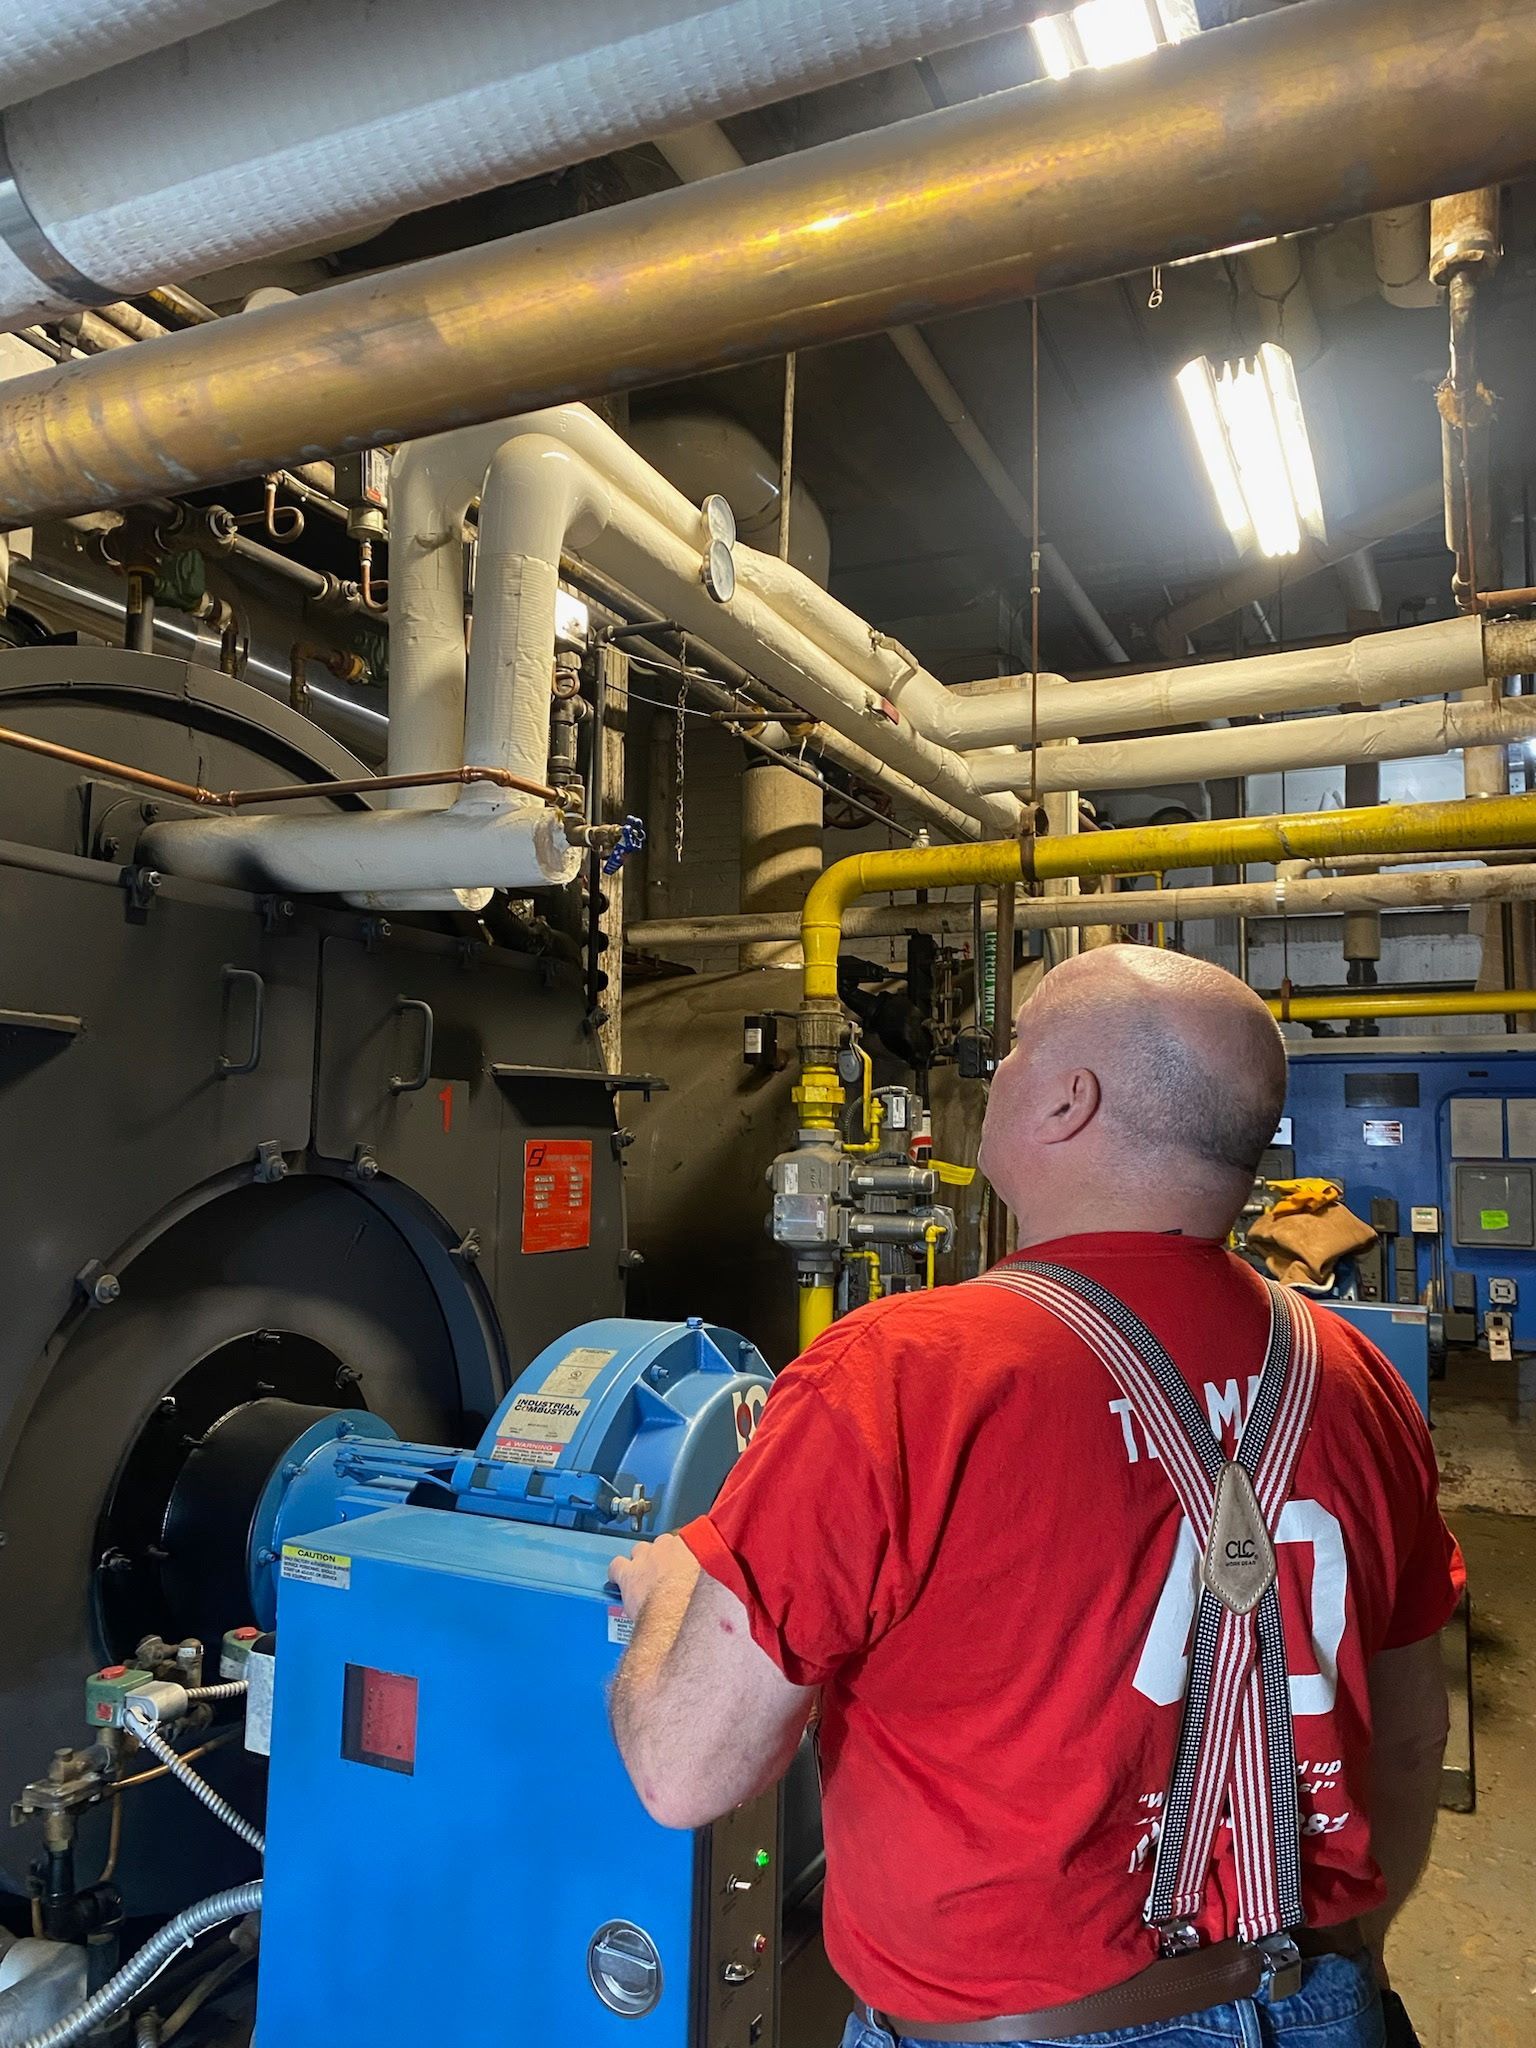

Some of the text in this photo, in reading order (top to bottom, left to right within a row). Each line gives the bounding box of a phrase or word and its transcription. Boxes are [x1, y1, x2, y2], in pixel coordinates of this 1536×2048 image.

[439, 1083, 453, 1133] 1
[514, 1405, 581, 1417] COMBUSTION
[517, 1399, 575, 1410] INDUSTRIAL
[513, 1441, 553, 1451] WARNING
[297, 1549, 336, 1562] CAUTION
[1225, 1539, 1255, 1559] CLC
[1312, 1760, 1341, 1776] up
